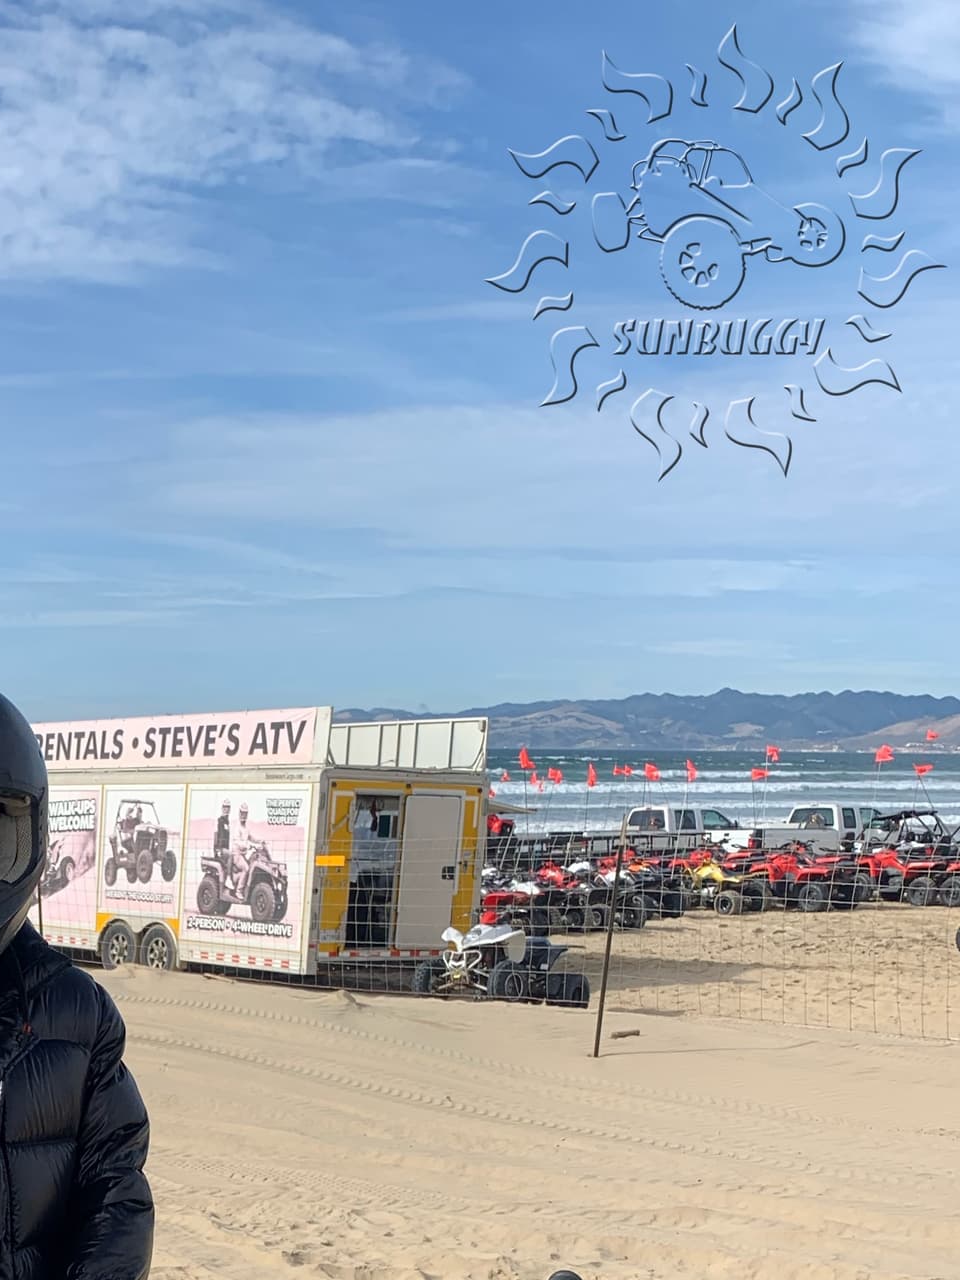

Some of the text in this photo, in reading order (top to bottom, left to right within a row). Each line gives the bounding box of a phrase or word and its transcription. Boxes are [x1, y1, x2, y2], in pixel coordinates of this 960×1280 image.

[143, 722, 241, 759] STEVE'S
[248, 720, 308, 756] ATV
[48, 798, 96, 817] WALK-UPS
[49, 814, 96, 833] WELCOME
[187, 915, 226, 931] 2-PERSON
[268, 923, 294, 939] DRIVE
